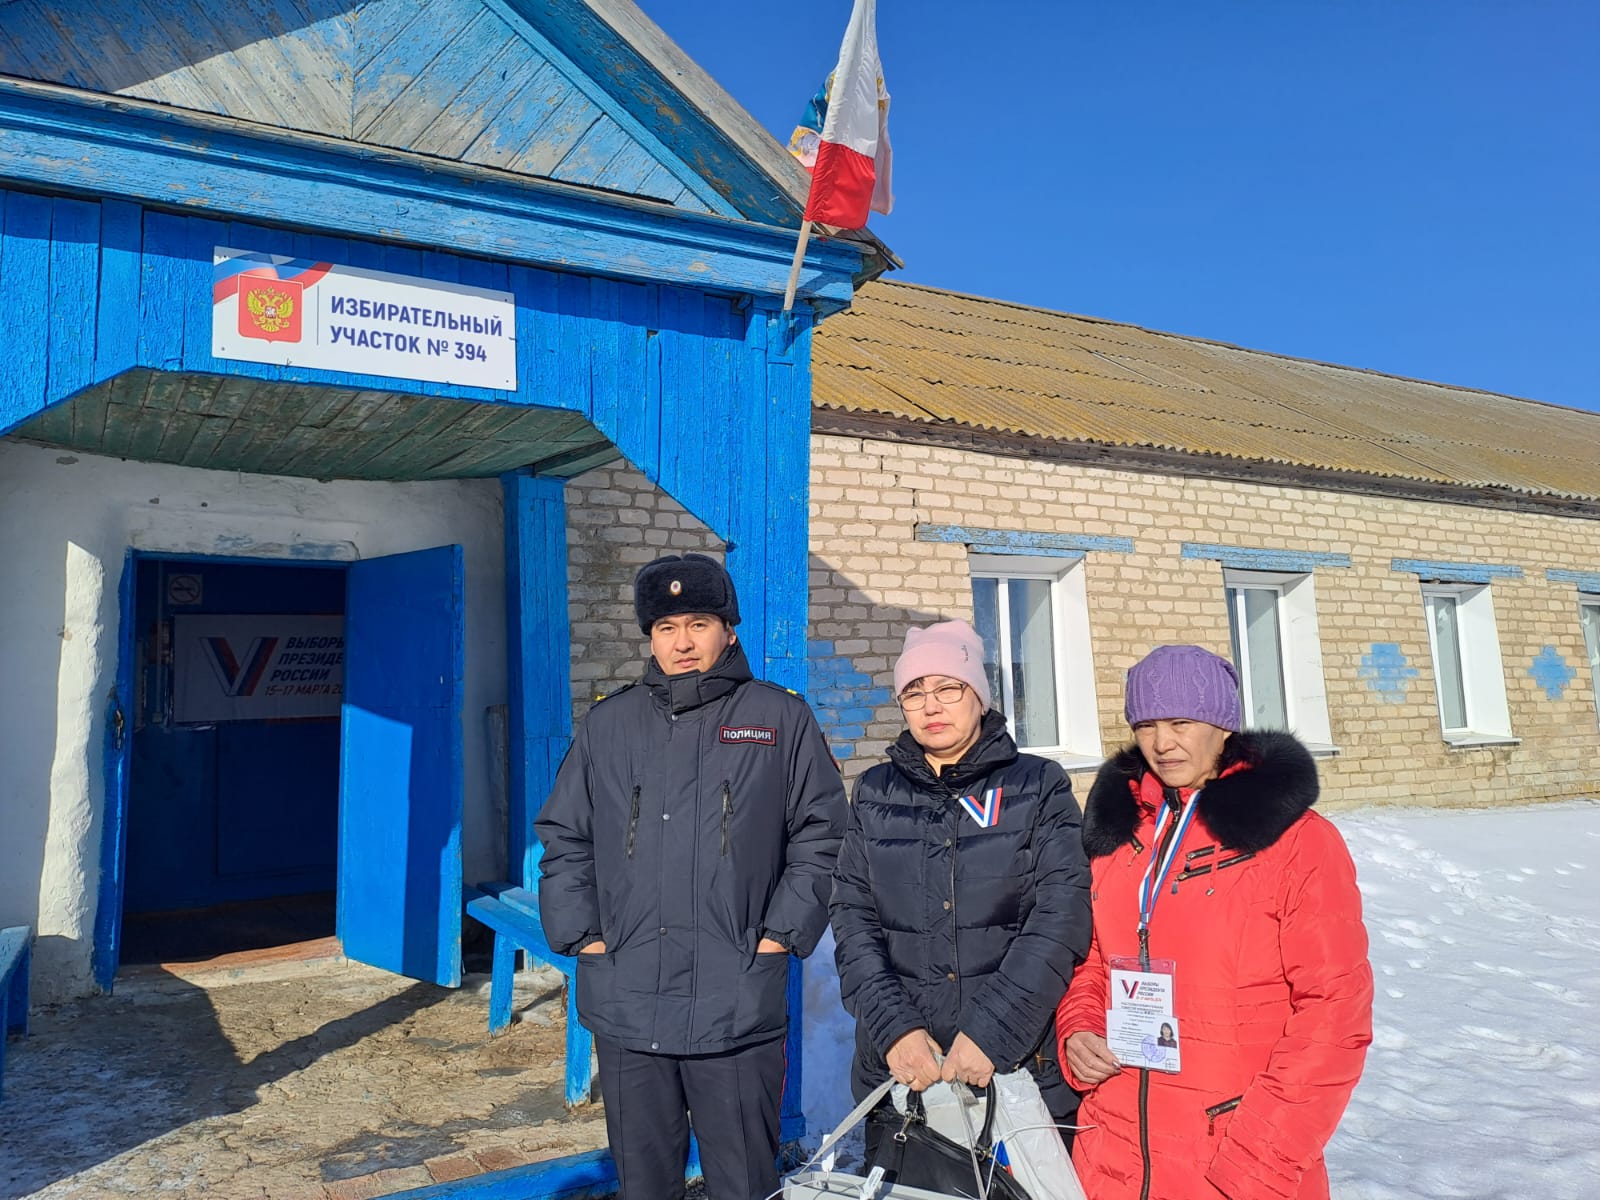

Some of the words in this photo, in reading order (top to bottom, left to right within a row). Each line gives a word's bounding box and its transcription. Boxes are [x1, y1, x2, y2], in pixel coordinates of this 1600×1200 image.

[331, 295, 502, 336] ИЗБИРАТЕЛЬНЫЙ
[330, 325, 421, 354] УЧАСТОК
[427, 338, 449, 357] №
[454, 341, 487, 362] 394
[270, 668, 330, 682] РОССИИ
[294, 684, 330, 695] МАРТА
[723, 729, 771, 740] ПОЛИЦИЯ
